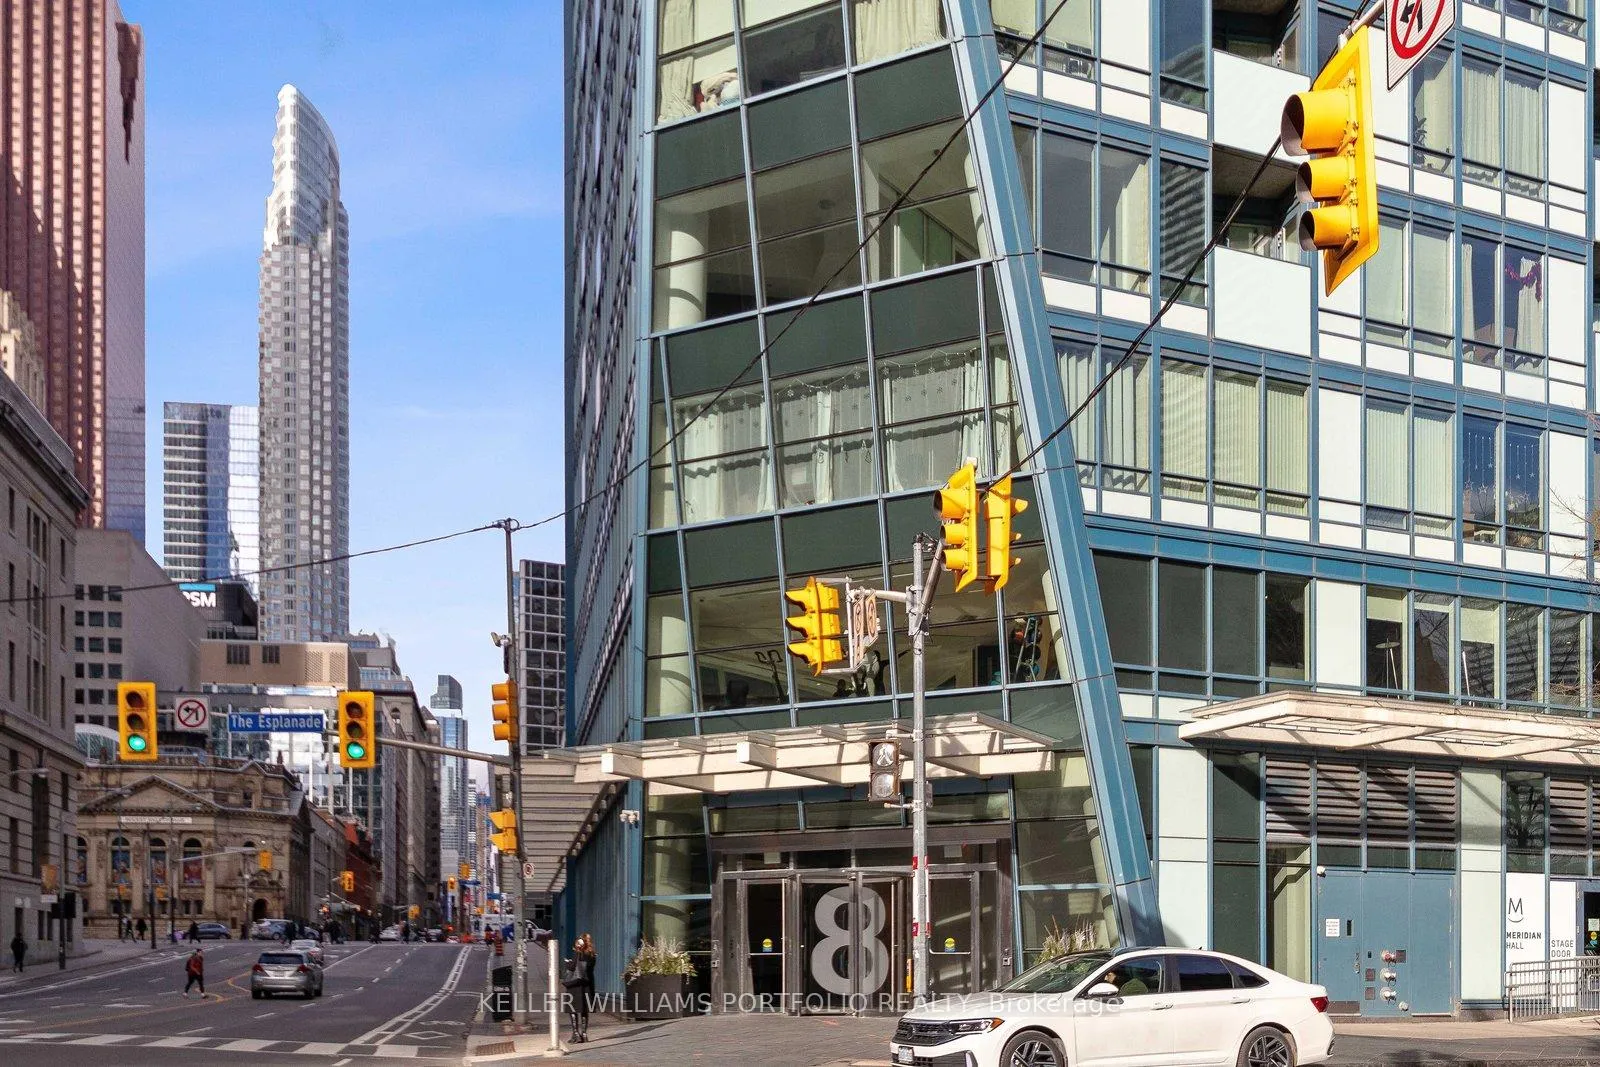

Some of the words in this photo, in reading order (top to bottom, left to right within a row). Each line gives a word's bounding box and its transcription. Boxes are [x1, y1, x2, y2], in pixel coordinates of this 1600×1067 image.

[231, 715, 253, 729] The
[259, 715, 321, 731] Esplanade
[1508, 898, 1523, 915] M
[811, 886, 890, 996] 8
